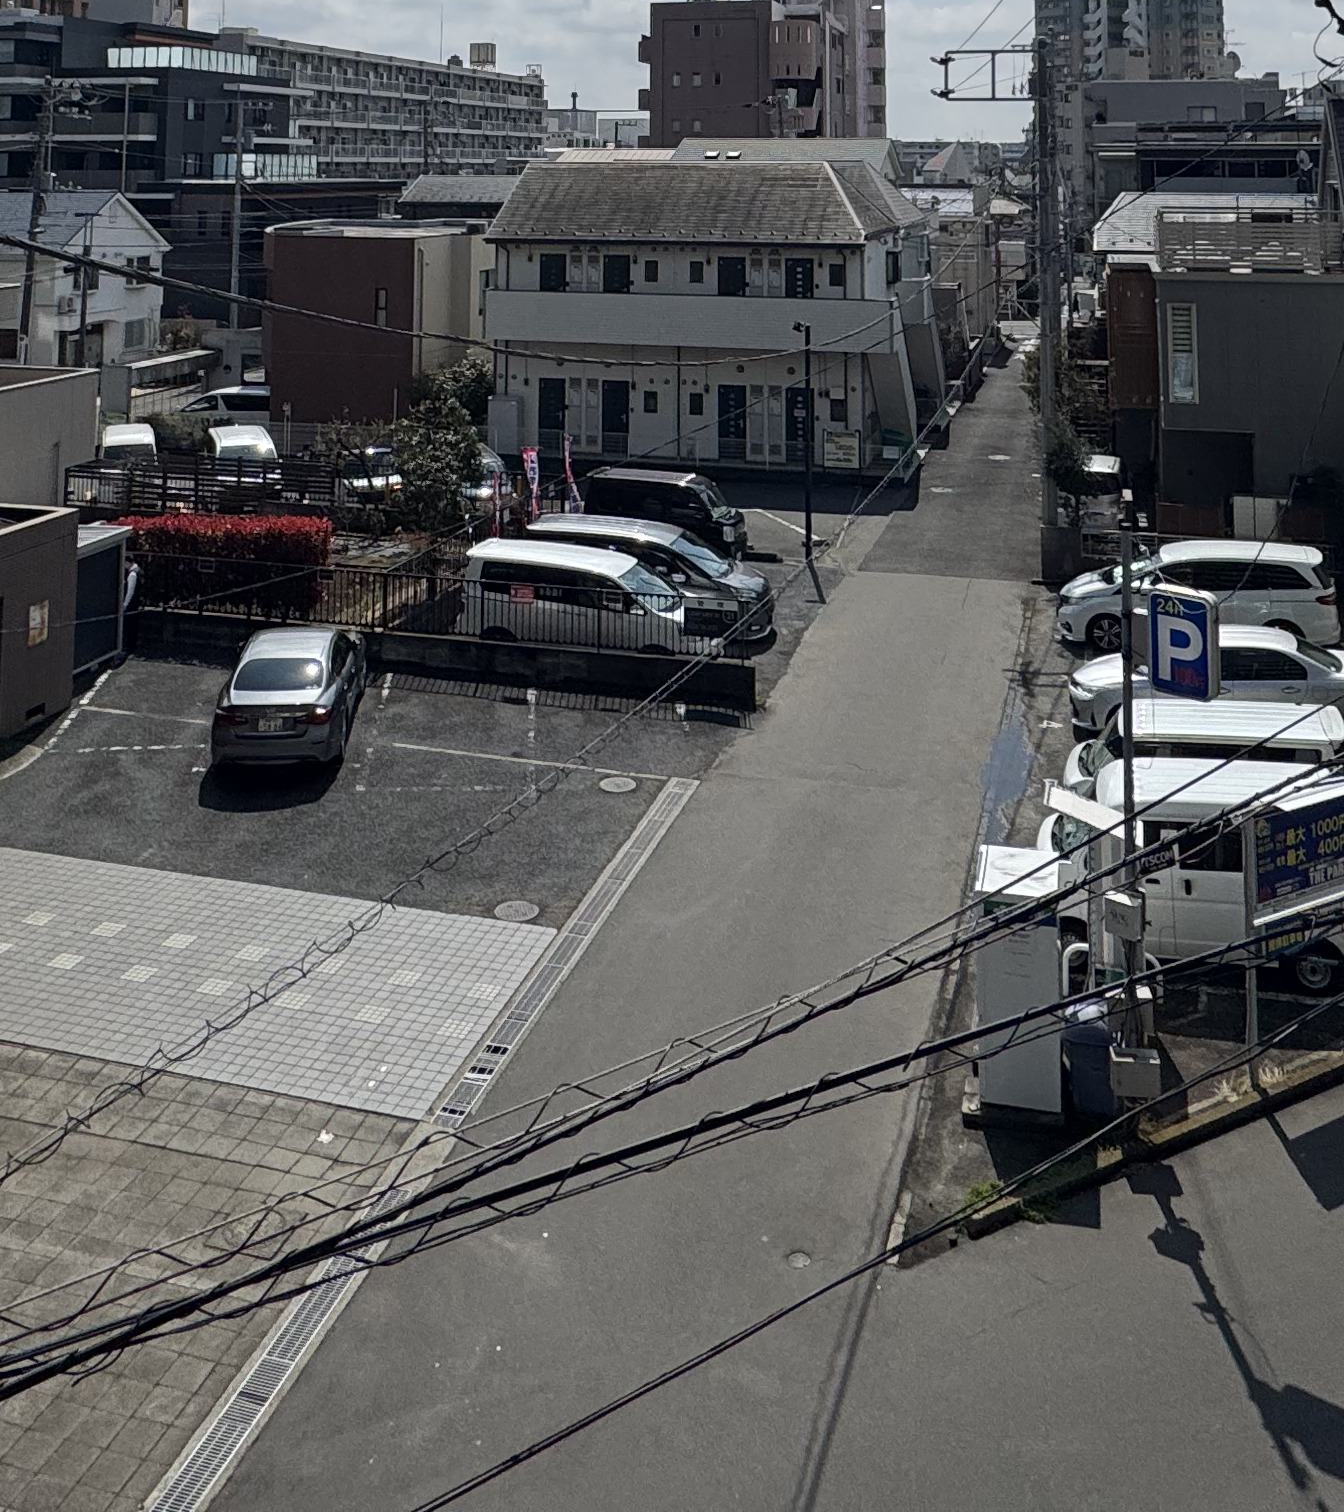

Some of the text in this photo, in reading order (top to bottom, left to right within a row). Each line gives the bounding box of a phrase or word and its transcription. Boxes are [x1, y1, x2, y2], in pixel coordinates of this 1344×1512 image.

[1157, 614, 1203, 681] P
[1286, 825, 1306, 846] 最大
[1287, 846, 1307, 867] 最大
